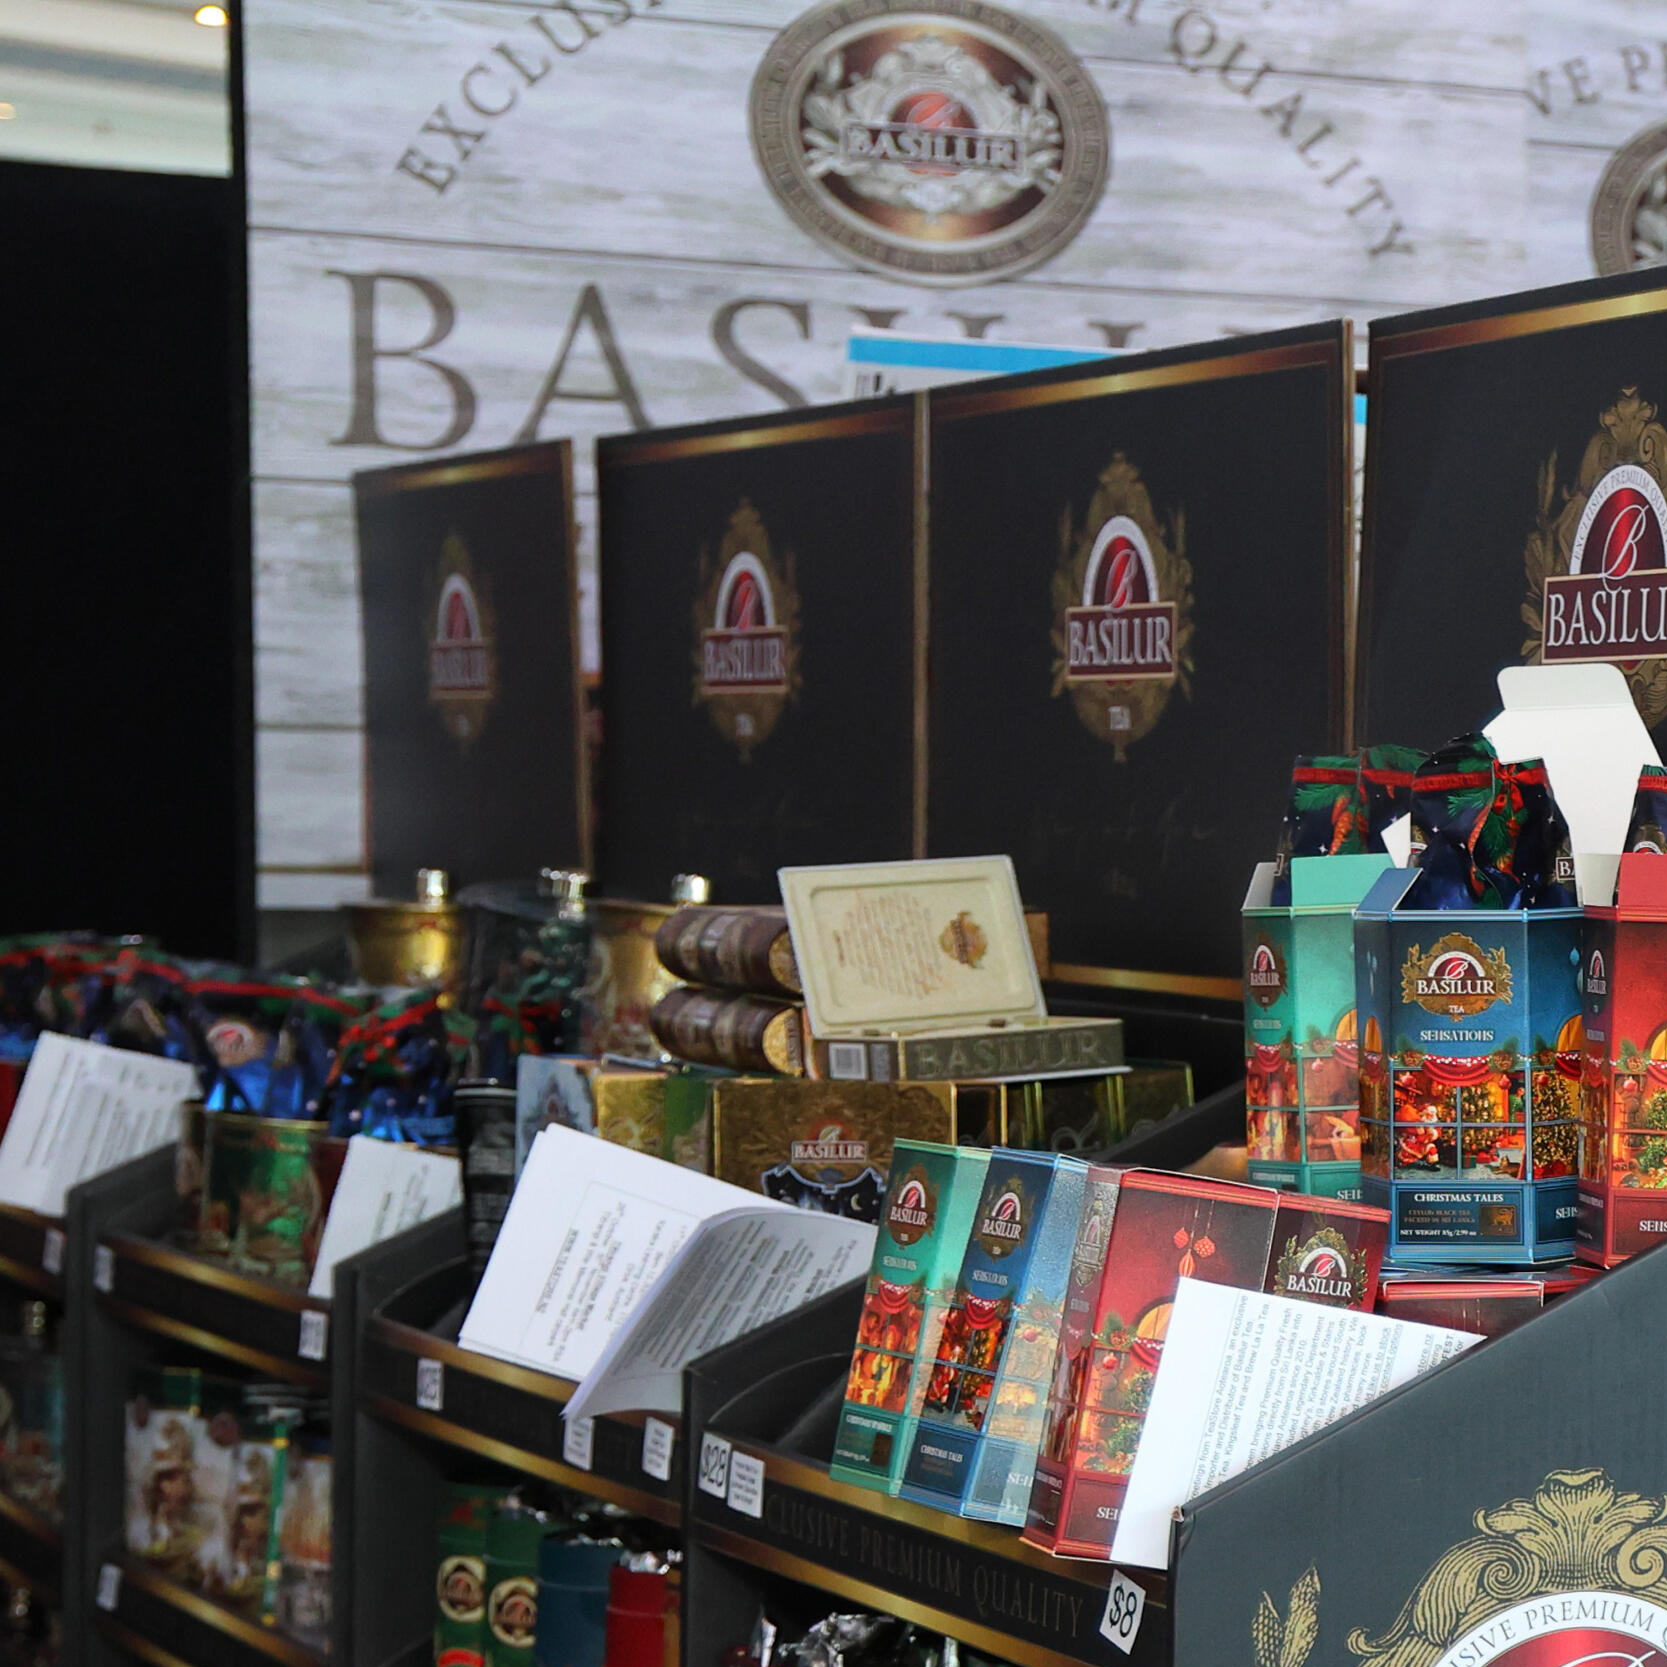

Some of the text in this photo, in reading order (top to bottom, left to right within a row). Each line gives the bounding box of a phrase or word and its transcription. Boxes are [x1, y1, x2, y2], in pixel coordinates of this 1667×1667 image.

[1068, 616, 1172, 667] BASILUR
[703, 638, 785, 682] BASILUR
[1417, 978, 1496, 996] BASILUR
[1420, 1029, 1494, 1042] SENSATIONS
[792, 1139, 868, 1165] BASILUR
[1414, 1192, 1504, 1203] CHRISTMAS TALES
[890, 1202, 928, 1229] BASILUR
[981, 1216, 1021, 1243] BASILUR
[1286, 1272, 1353, 1299] BASILUR
[1107, 1582, 1138, 1639] $8
[1523, 1599, 1653, 1633] PREMIUM
